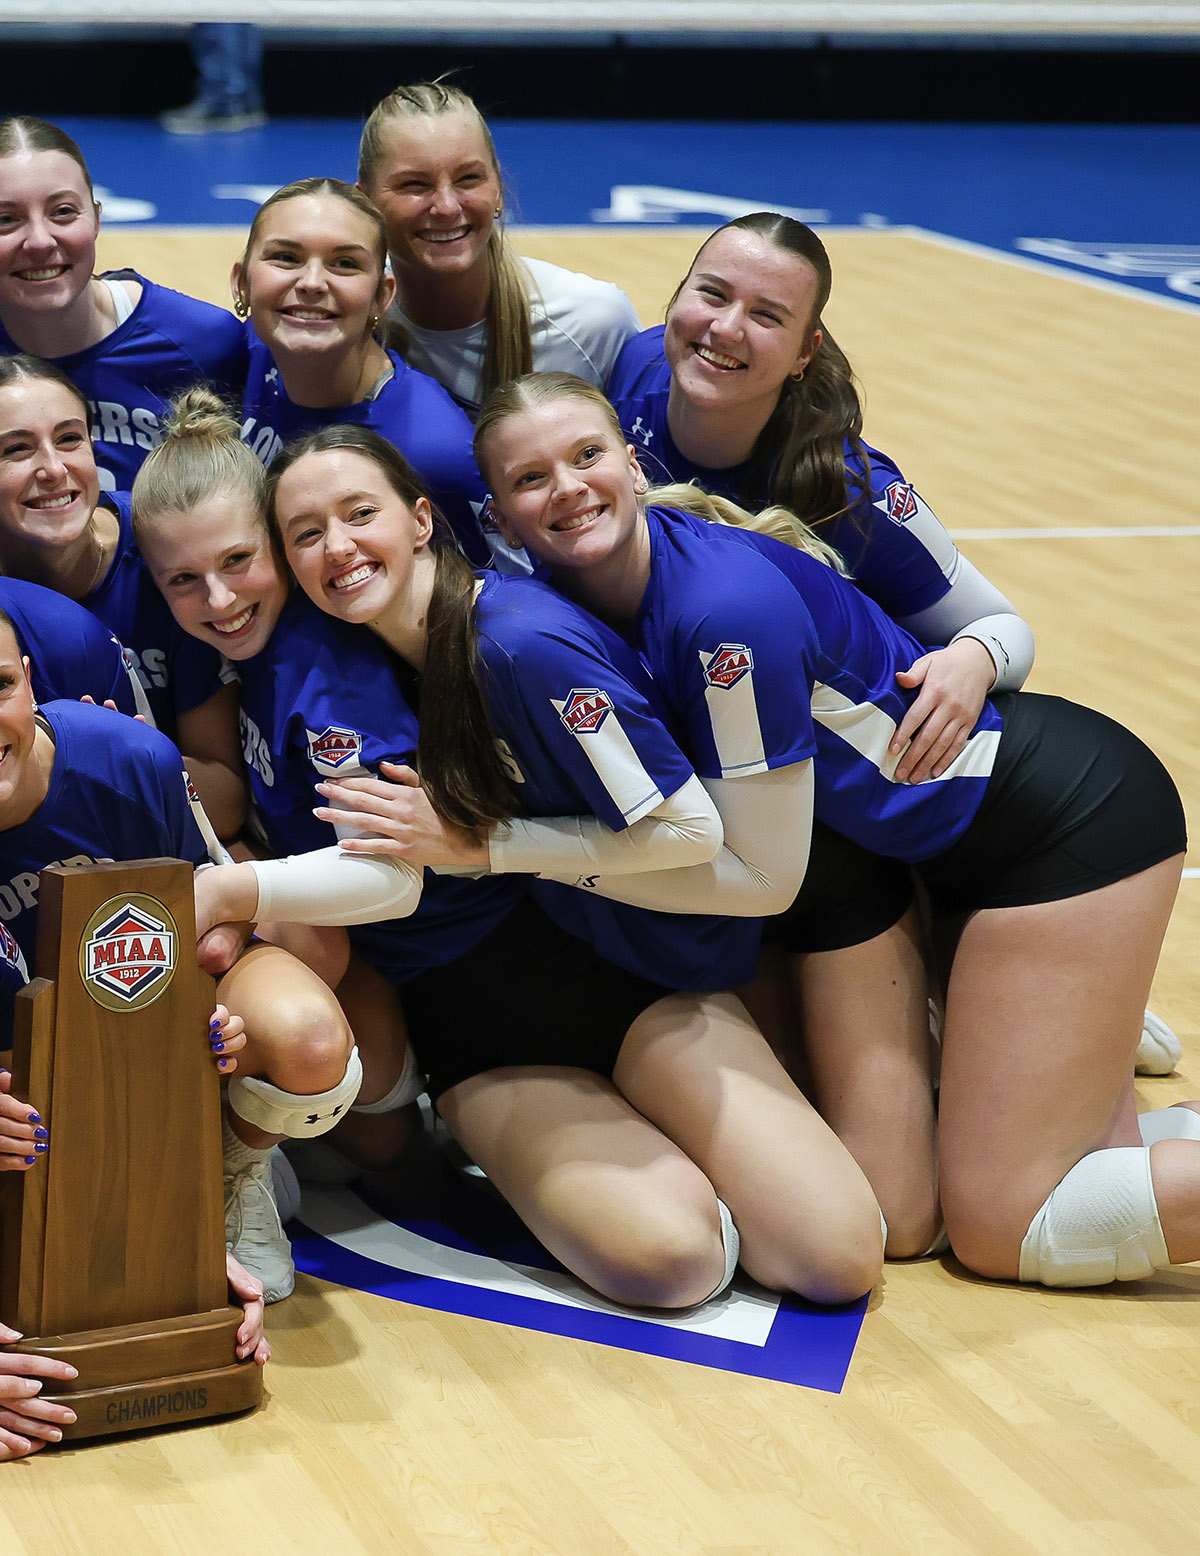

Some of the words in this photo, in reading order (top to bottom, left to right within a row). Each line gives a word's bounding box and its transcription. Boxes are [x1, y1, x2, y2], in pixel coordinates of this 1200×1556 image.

[566, 697, 609, 728] MIAA
[312, 738, 358, 754] MIAA
[94, 937, 166, 968] MIAA
[119, 968, 140, 979] 1912
[106, 1387, 209, 1425] CHAMPIONS
